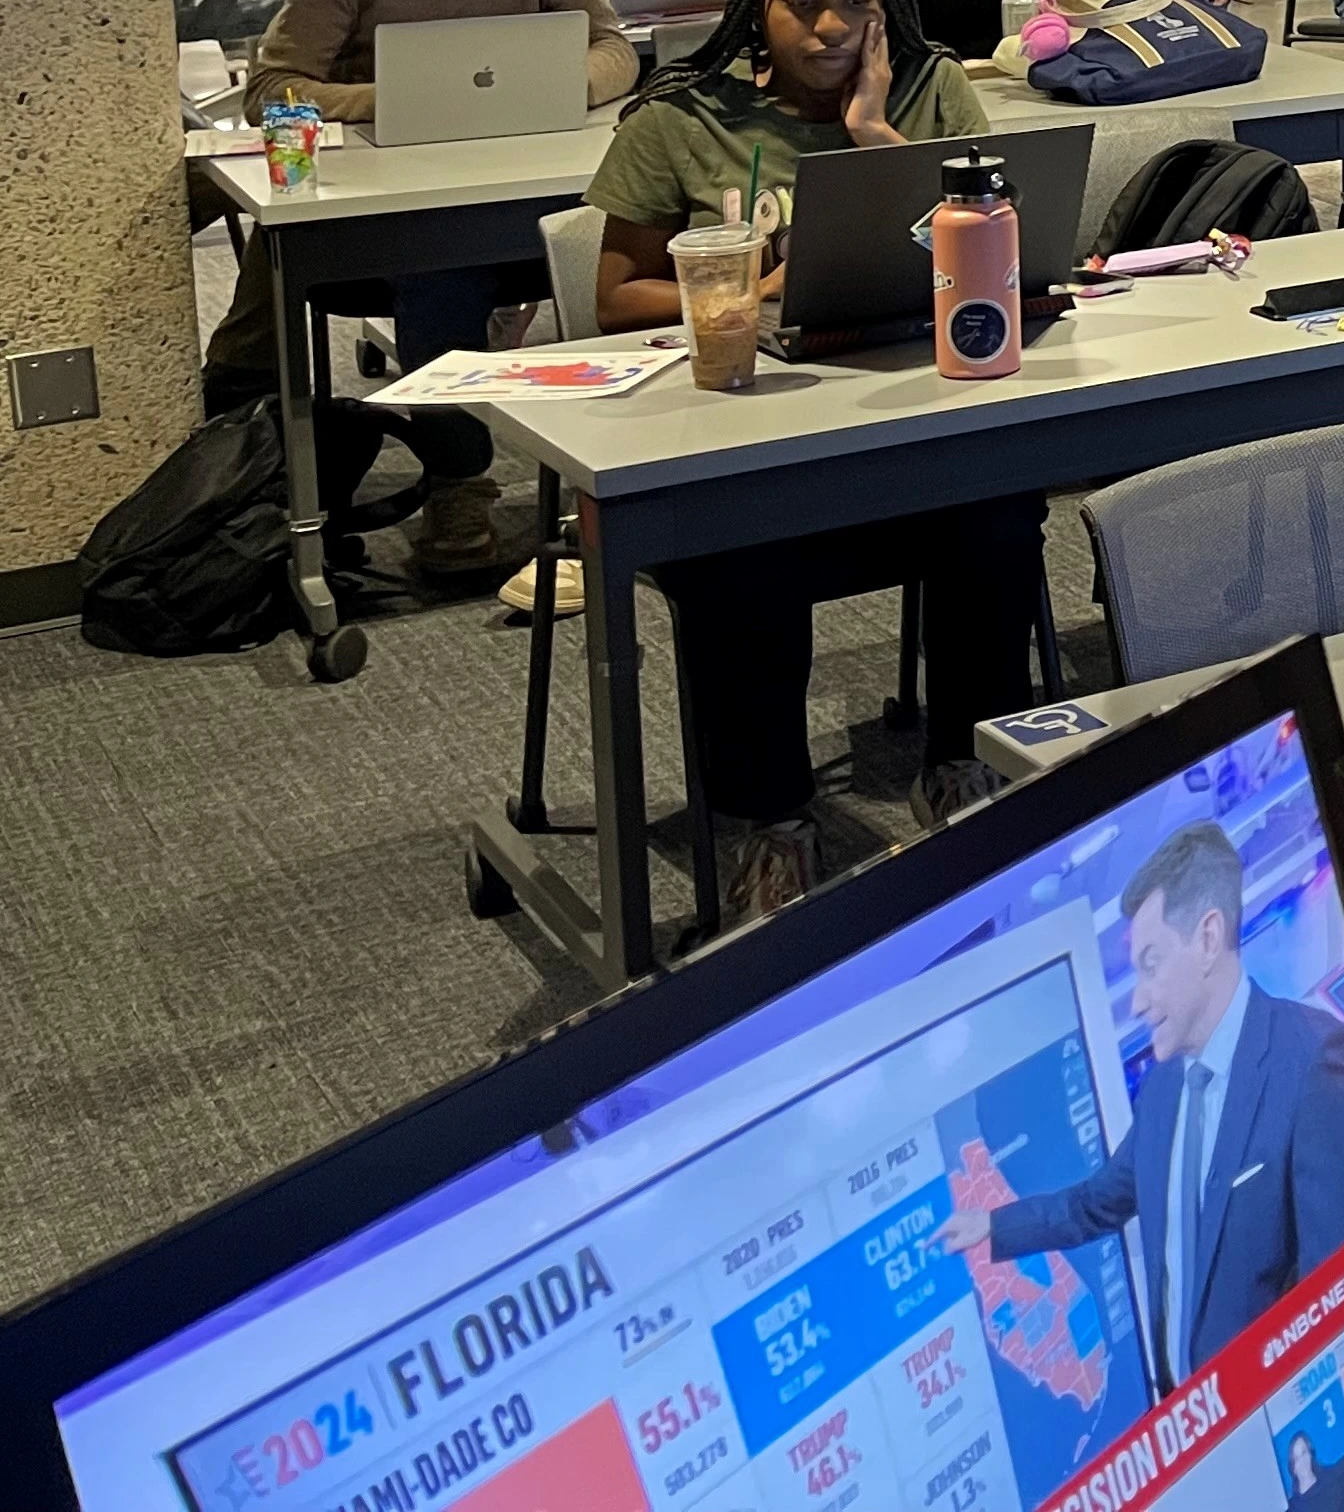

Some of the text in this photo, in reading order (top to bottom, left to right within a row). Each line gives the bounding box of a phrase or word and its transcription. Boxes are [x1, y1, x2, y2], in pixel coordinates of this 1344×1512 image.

[886, 1138, 919, 1172] PRES
[766, 1208, 804, 1247] PRES
[864, 1199, 936, 1267] CLINTON
[901, 1326, 956, 1385] TRUMP
[1281, 1301, 1323, 1354] NBC
[263, 1245, 615, 1486] 2024 FLORIDA
[491, 1392, 534, 1450] CO
[636, 1380, 722, 1455] 55.1%
[785, 1408, 848, 1474] TRUMP
[1052, 1371, 1228, 1512] CISION DESK
[923, 1430, 993, 1508] JOHNSON
